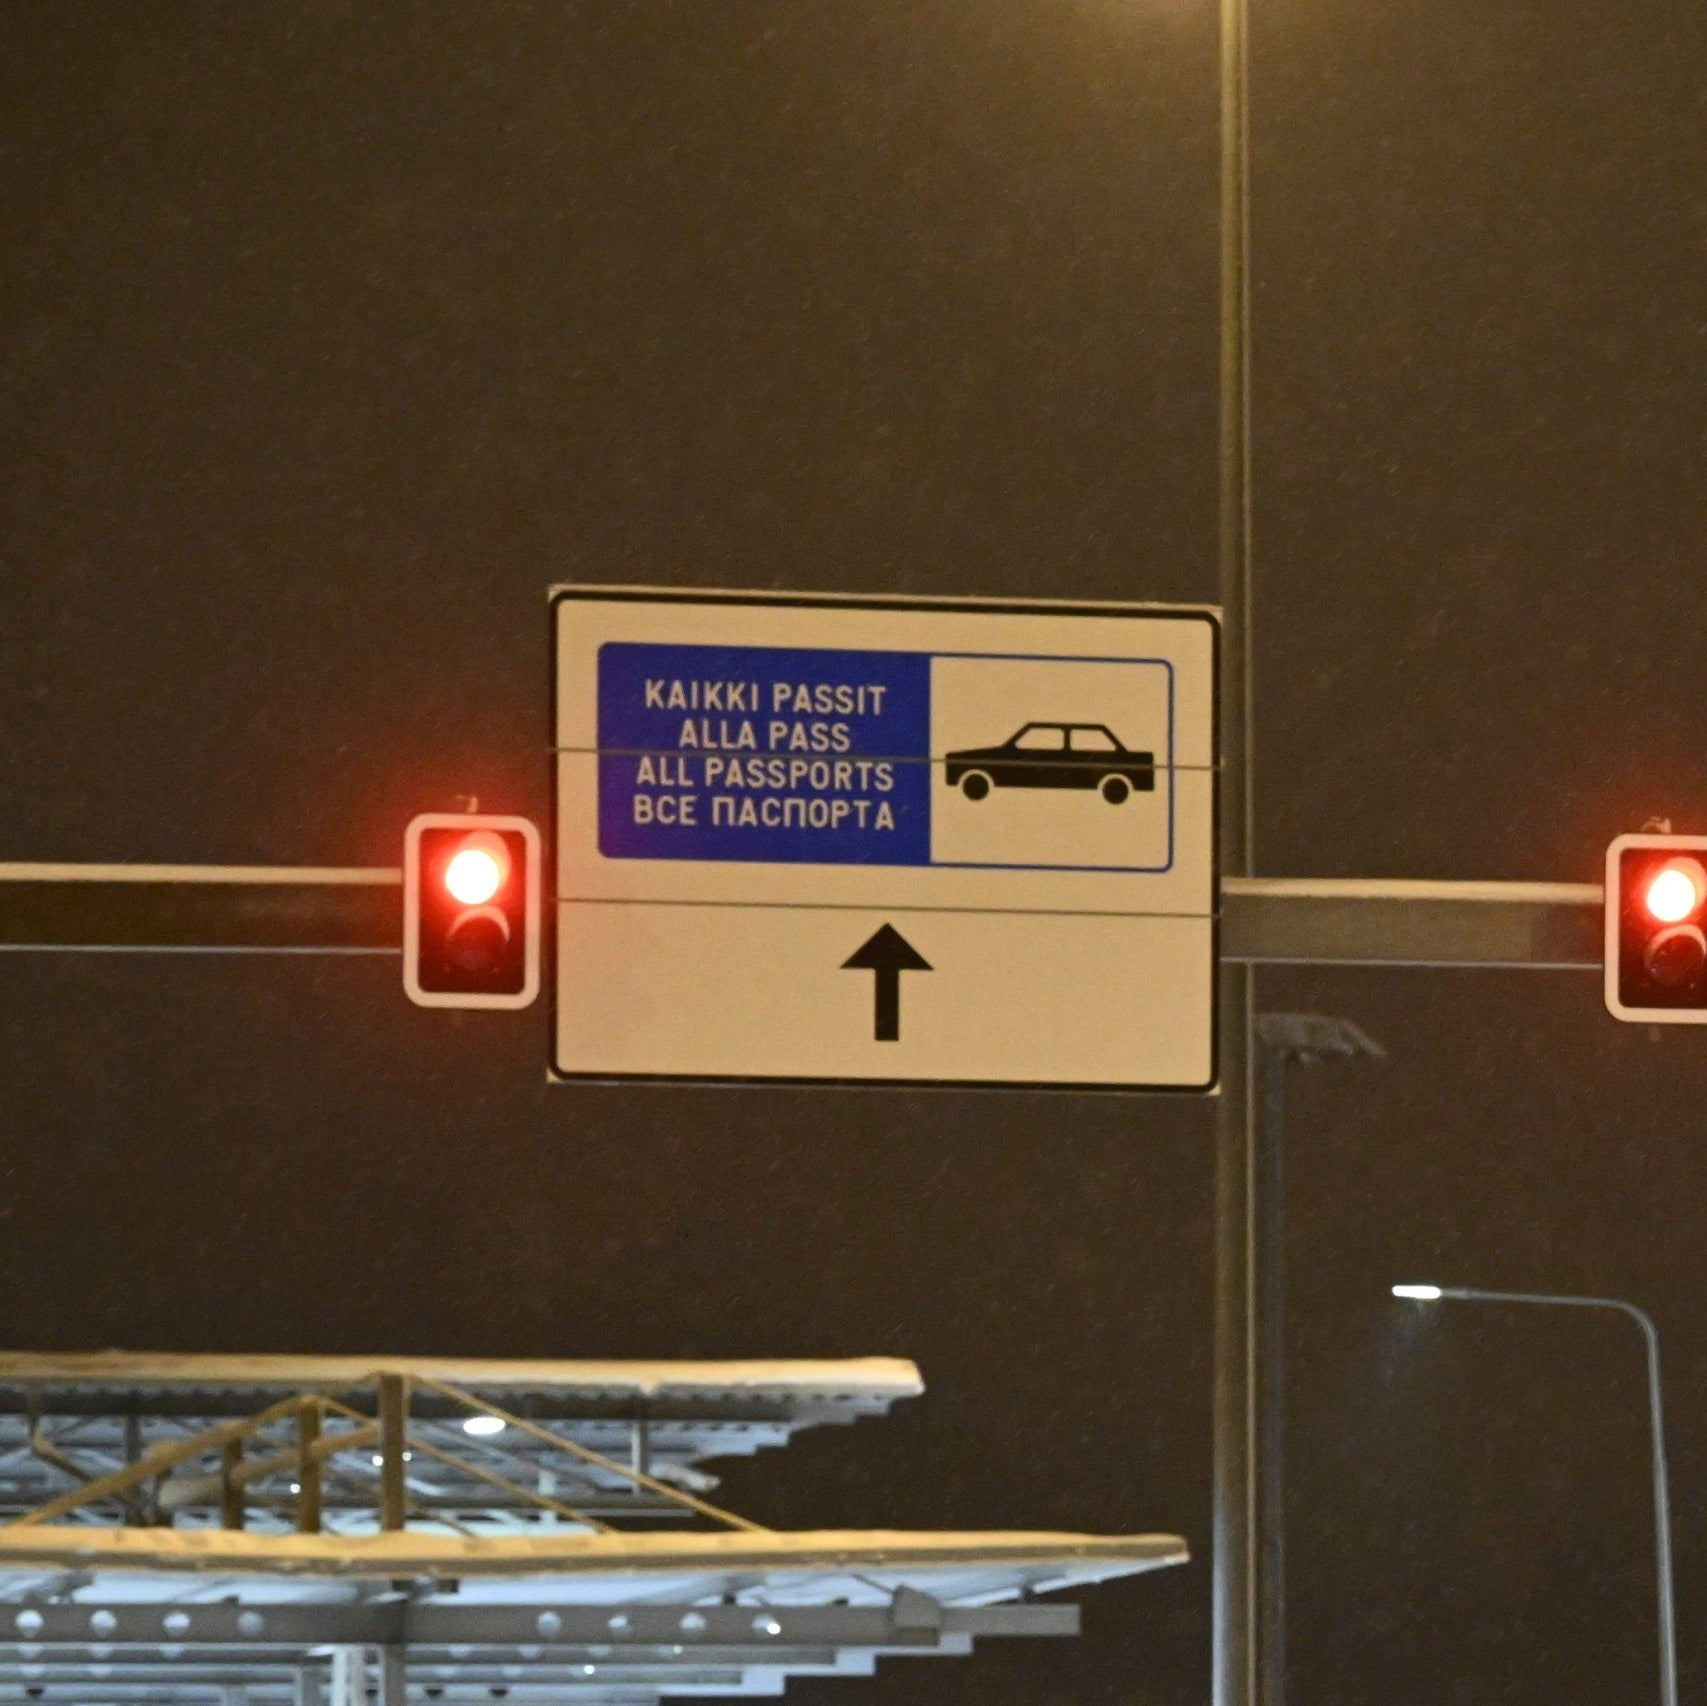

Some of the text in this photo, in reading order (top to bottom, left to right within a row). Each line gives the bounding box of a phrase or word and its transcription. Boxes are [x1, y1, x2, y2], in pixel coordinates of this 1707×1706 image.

[645, 679, 887, 716] KAIKKI PASSIT
[679, 719, 850, 752] ALLA PASS
[636, 755, 894, 792] ALL PASSPORTS
[634, 794, 895, 830] ВСЕ ПАСПОРТА
